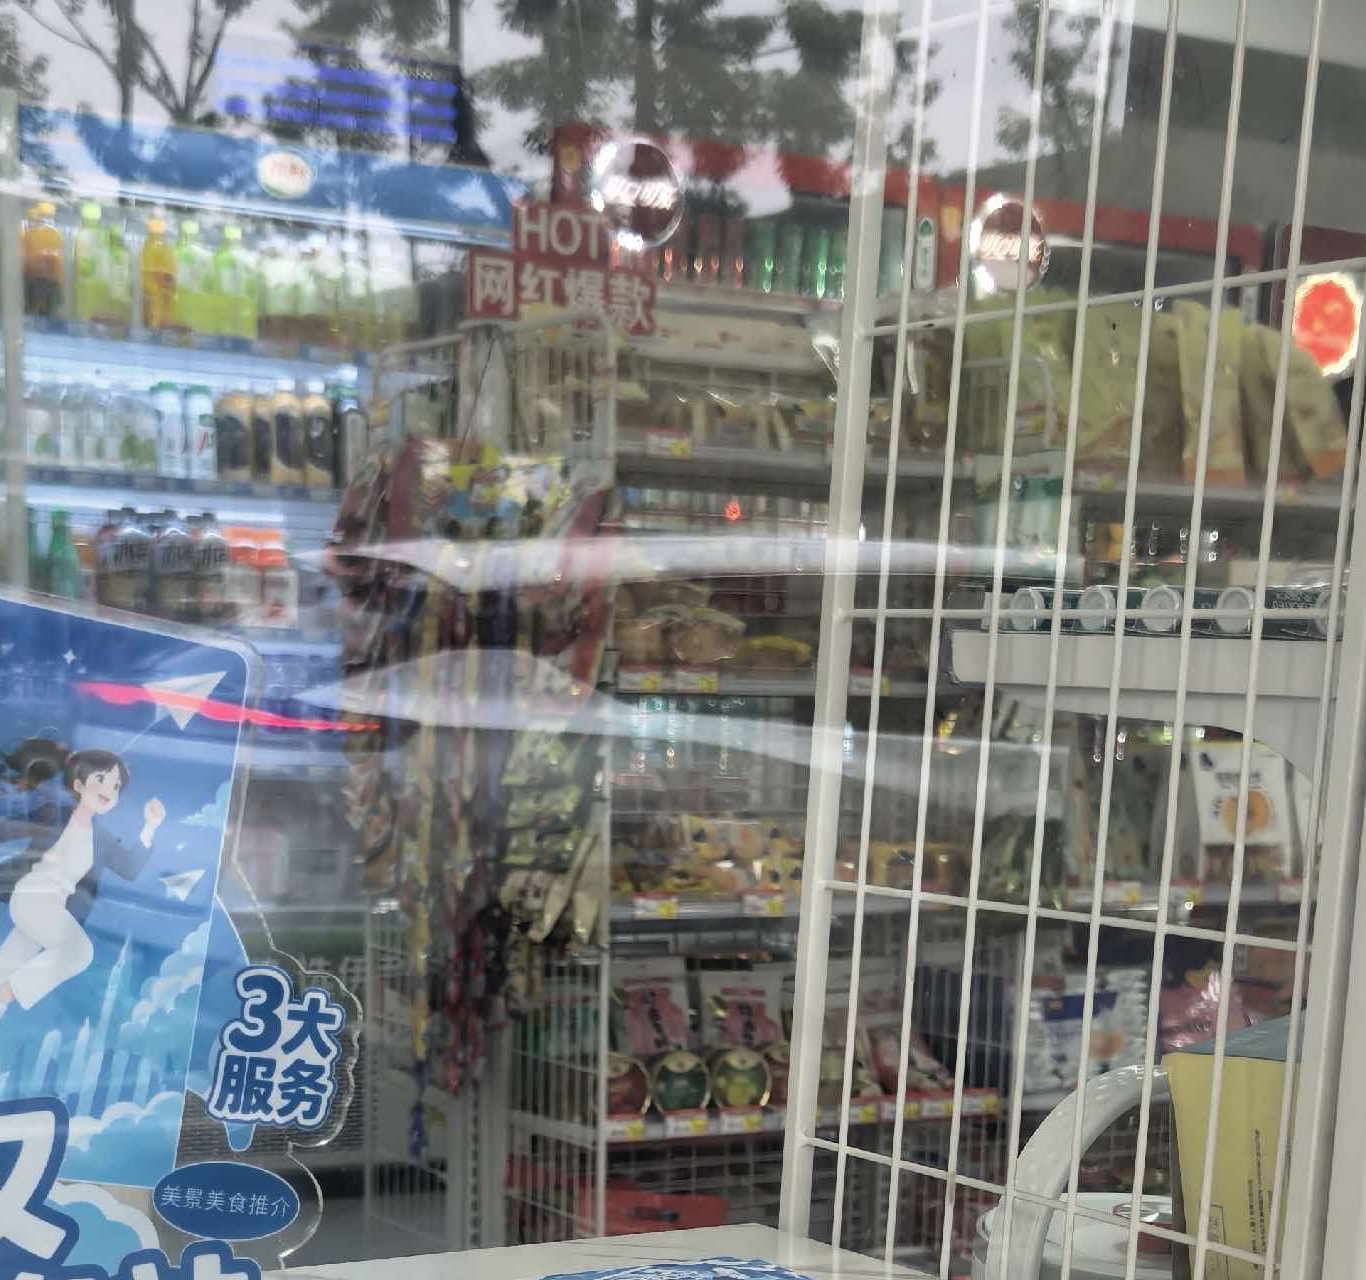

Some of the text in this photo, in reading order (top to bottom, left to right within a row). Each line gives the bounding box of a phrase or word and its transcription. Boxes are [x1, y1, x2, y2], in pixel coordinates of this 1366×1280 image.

[519, 207, 605, 259] HOT
[474, 255, 655, 329] 网红爆款
[227, 972, 337, 1058] 3大
[213, 1055, 329, 1122] 服务
[160, 1184, 291, 1217] 美景美食推介
